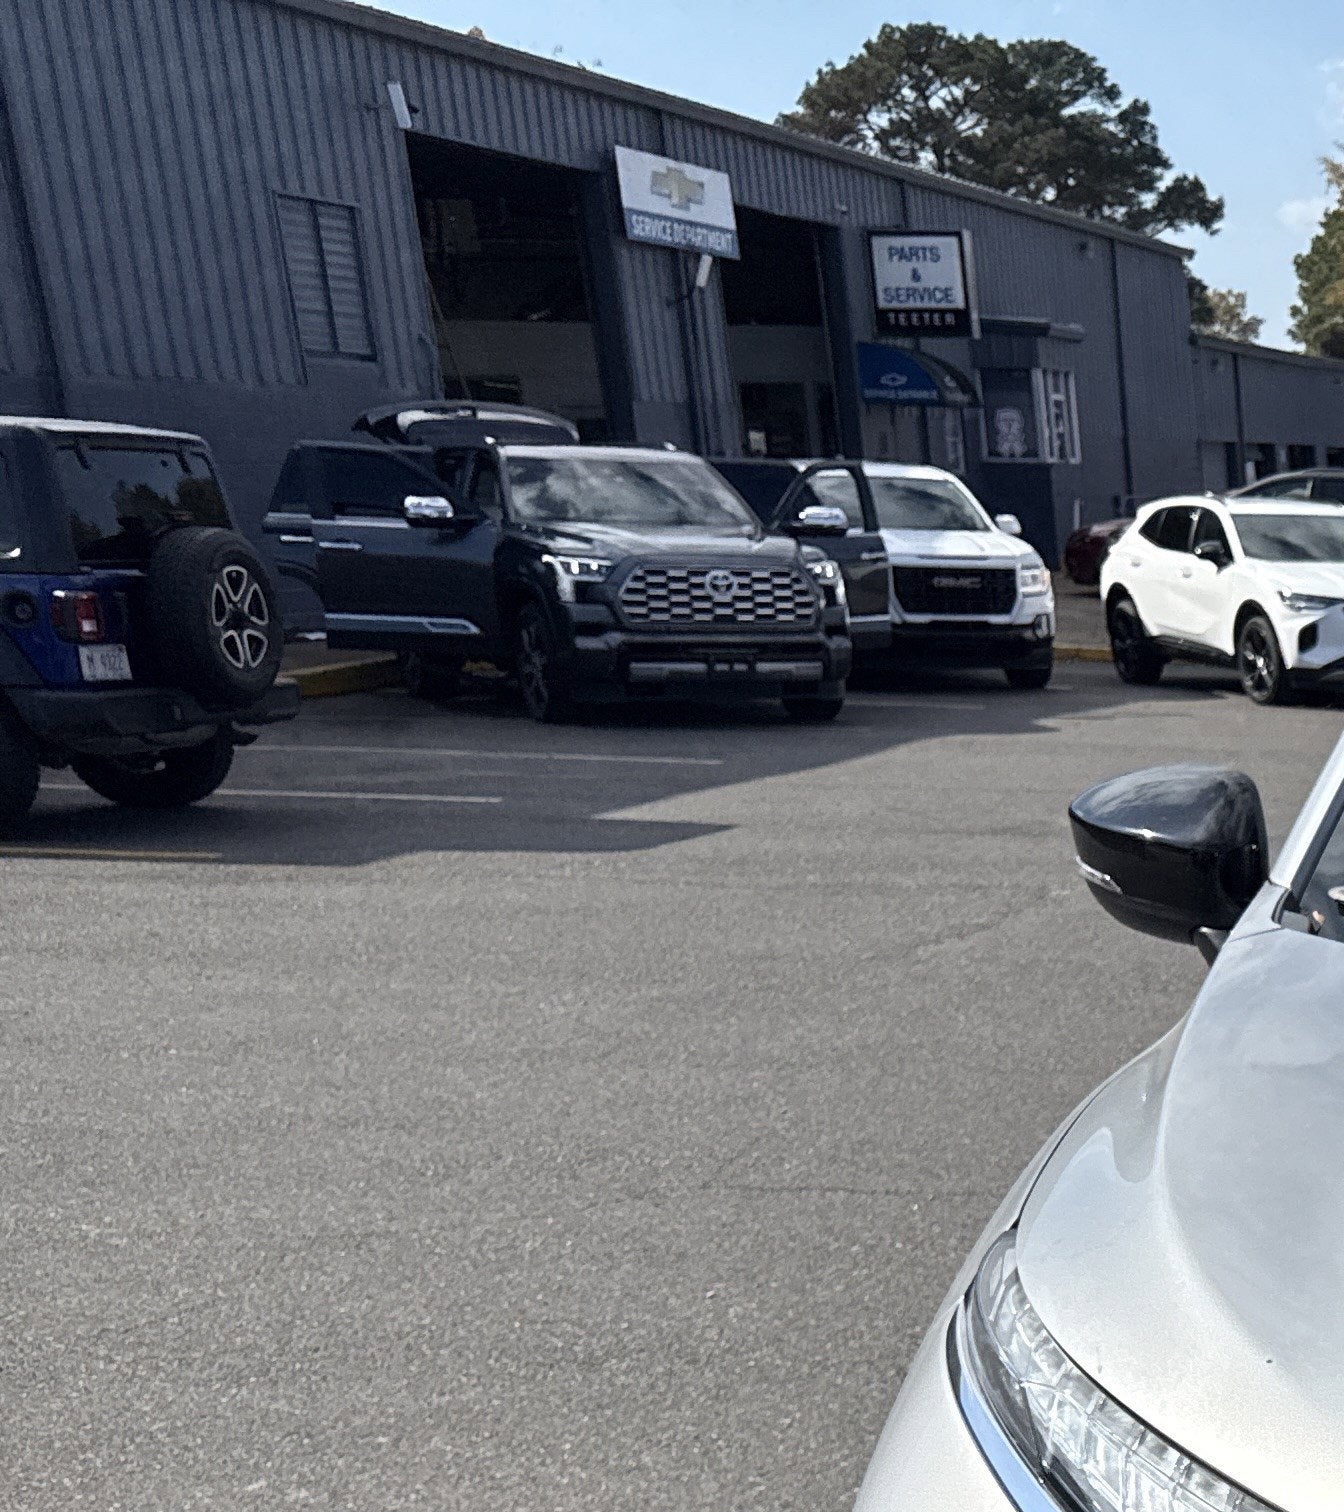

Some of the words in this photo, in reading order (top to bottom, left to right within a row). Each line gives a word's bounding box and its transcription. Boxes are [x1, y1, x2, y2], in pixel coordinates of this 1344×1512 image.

[631, 213, 674, 243] SERVICE
[886, 245, 942, 263] PARTS
[911, 266, 922, 283] &
[882, 286, 956, 304] SERVICE
